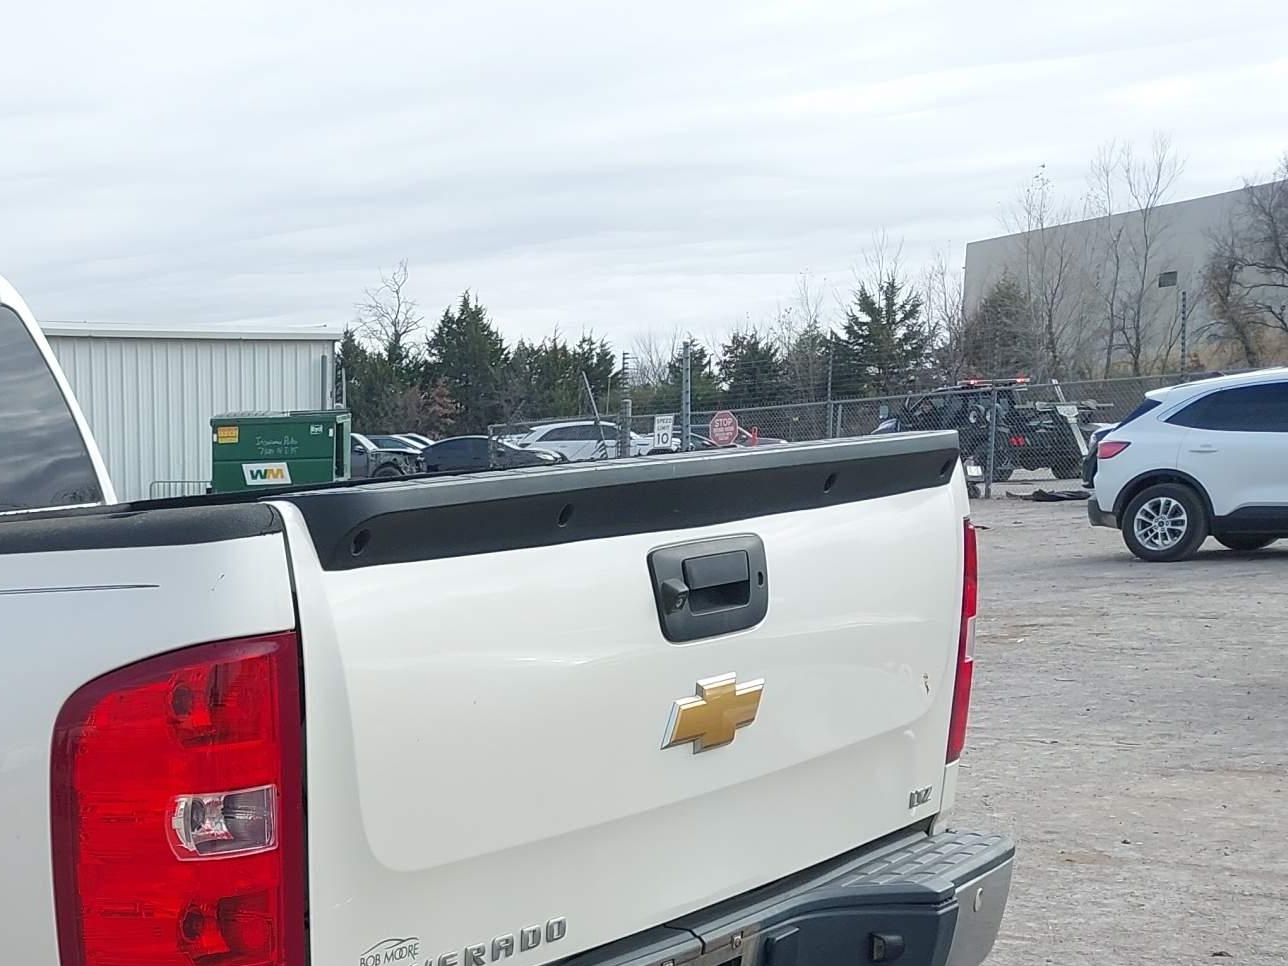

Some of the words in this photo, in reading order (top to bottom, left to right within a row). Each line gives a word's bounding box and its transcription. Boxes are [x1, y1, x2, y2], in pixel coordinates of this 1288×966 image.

[714, 418, 733, 427] STOP
[657, 433, 669, 445] 10
[249, 468, 285, 480] WM
[384, 942, 420, 964] MOORE
